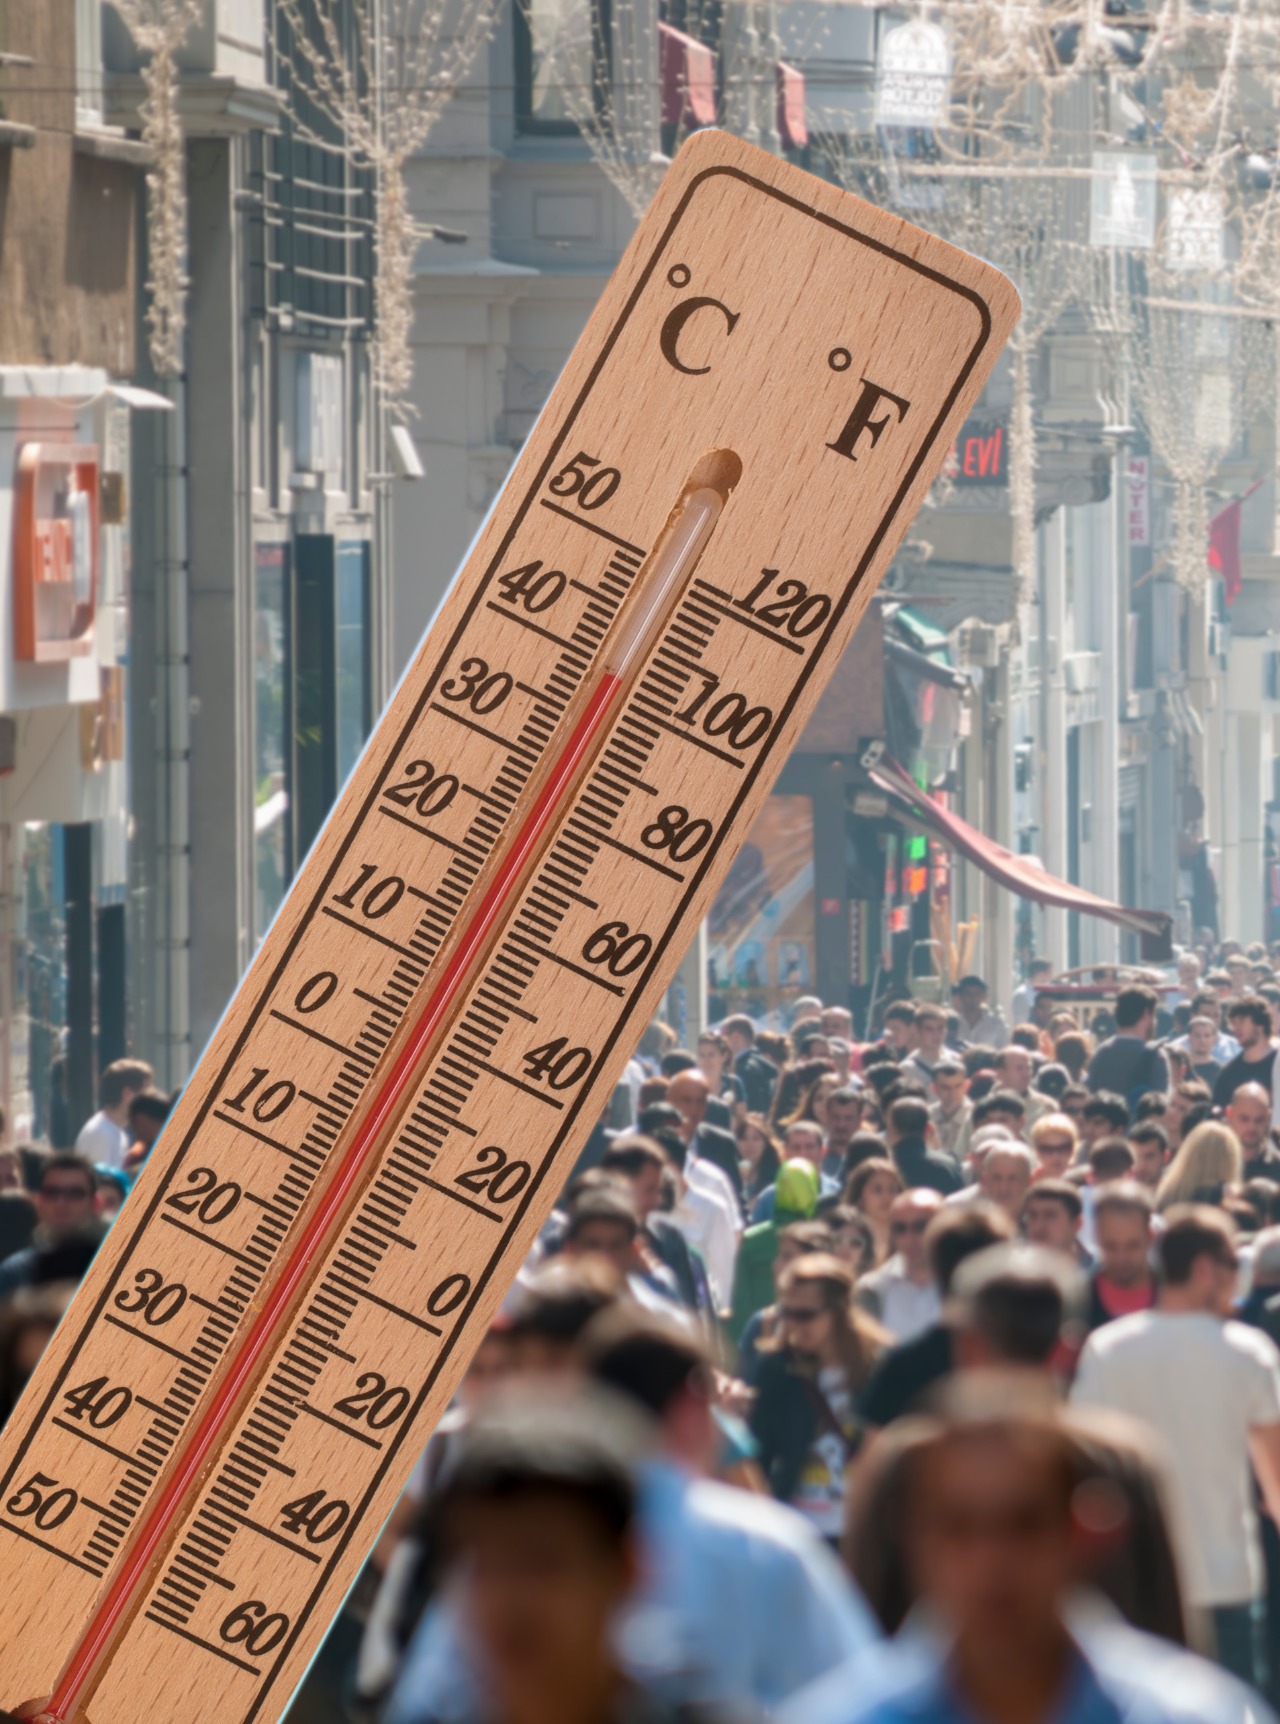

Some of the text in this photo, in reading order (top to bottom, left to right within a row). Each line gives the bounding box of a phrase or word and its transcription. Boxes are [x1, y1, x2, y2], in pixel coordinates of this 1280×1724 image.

[549, 452, 621, 510] 50
[498, 561, 566, 613] 40
[733, 569, 831, 637] 120
[441, 658, 513, 714] 30
[674, 679, 773, 750] 100
[383, 760, 459, 816] 20
[641, 805, 713, 862] 80
[332, 864, 405, 919] 10
[582, 922, 652, 976] 60
[295, 972, 338, 1013] 0
[523, 1037, 592, 1089] 40
[223, 1068, 296, 1122] 10
[166, 1168, 241, 1224] 20
[454, 1146, 531, 1203] 20
[115, 1269, 187, 1325] 30
[427, 1274, 470, 1316] 0
[64, 1376, 132, 1428] 40
[333, 1372, 410, 1429] 20
[6, 1472, 78, 1530] 50
[280, 1490, 350, 1543] 40
[220, 1601, 289, 1656] 60
